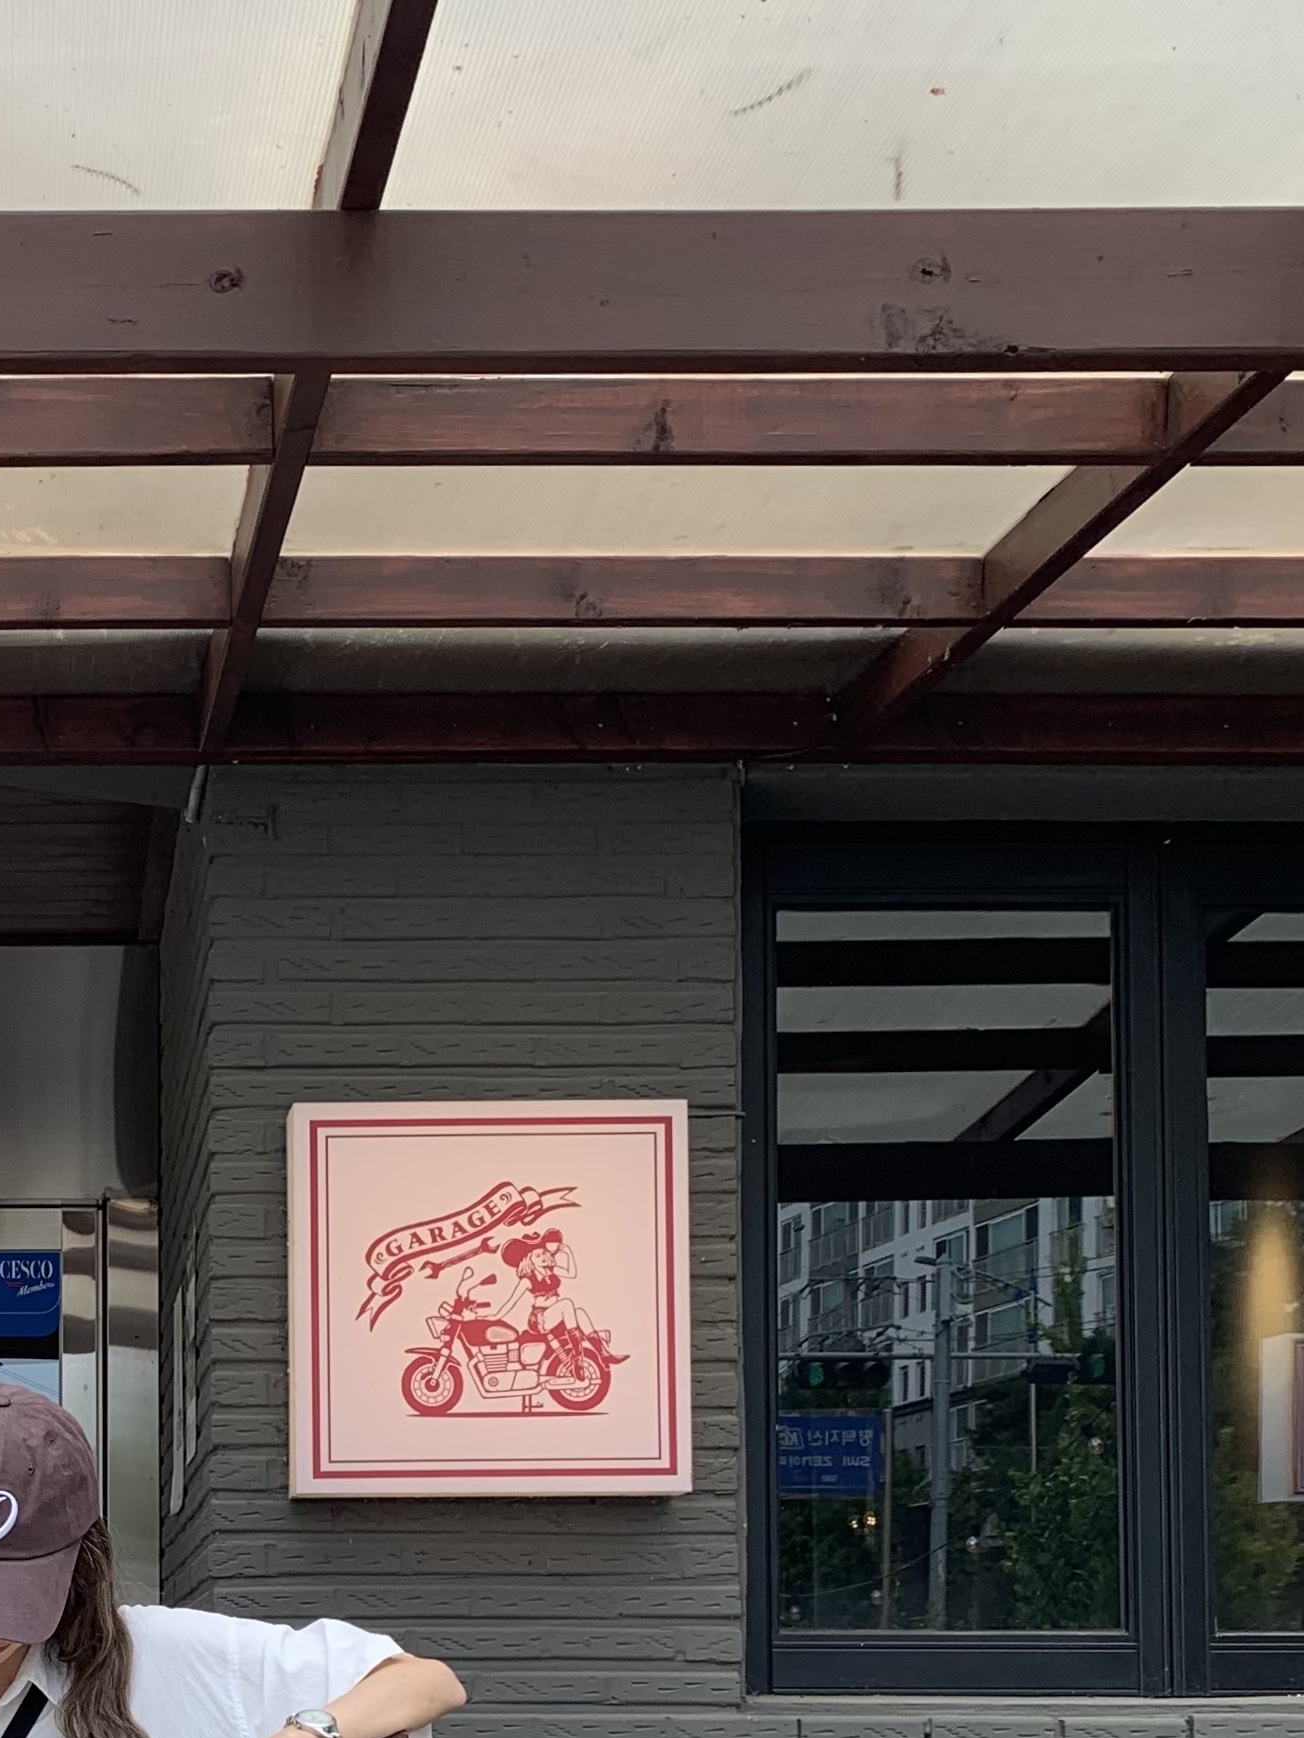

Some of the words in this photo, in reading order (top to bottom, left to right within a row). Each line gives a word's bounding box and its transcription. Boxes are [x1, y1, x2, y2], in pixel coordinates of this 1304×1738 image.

[385, 1200, 502, 1257] GARAGE
[0, 1260, 54, 1279] CESCO
[16, 1280, 55, 1297] Members
